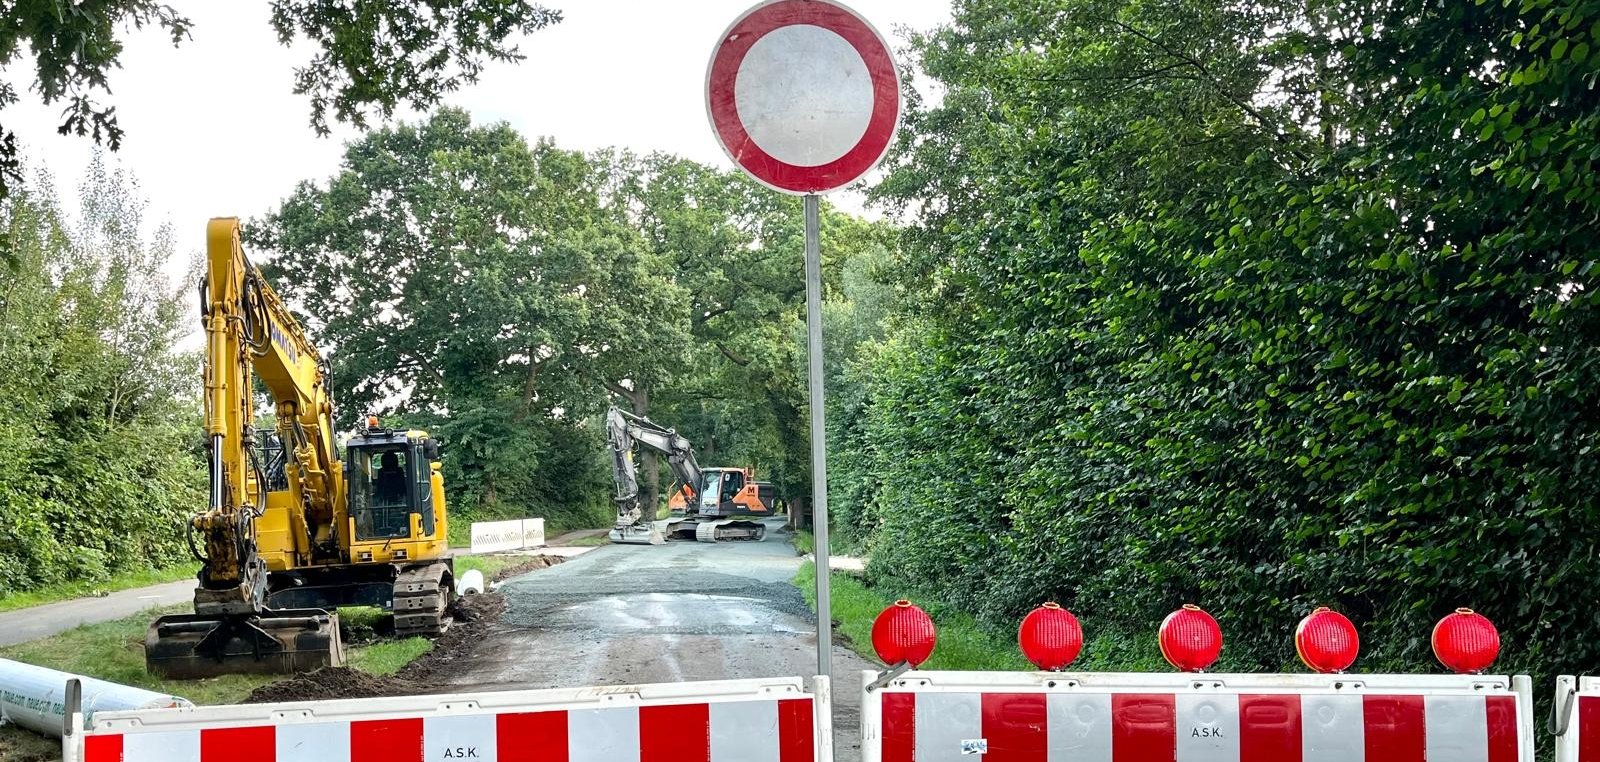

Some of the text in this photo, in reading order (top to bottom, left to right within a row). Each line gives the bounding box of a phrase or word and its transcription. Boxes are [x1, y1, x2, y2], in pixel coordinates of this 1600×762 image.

[270, 320, 296, 365] OMATSU
[747, 486, 755, 494] M
[1191, 727, 1223, 738] A.S.K.
[444, 747, 480, 758] A.S.K.
